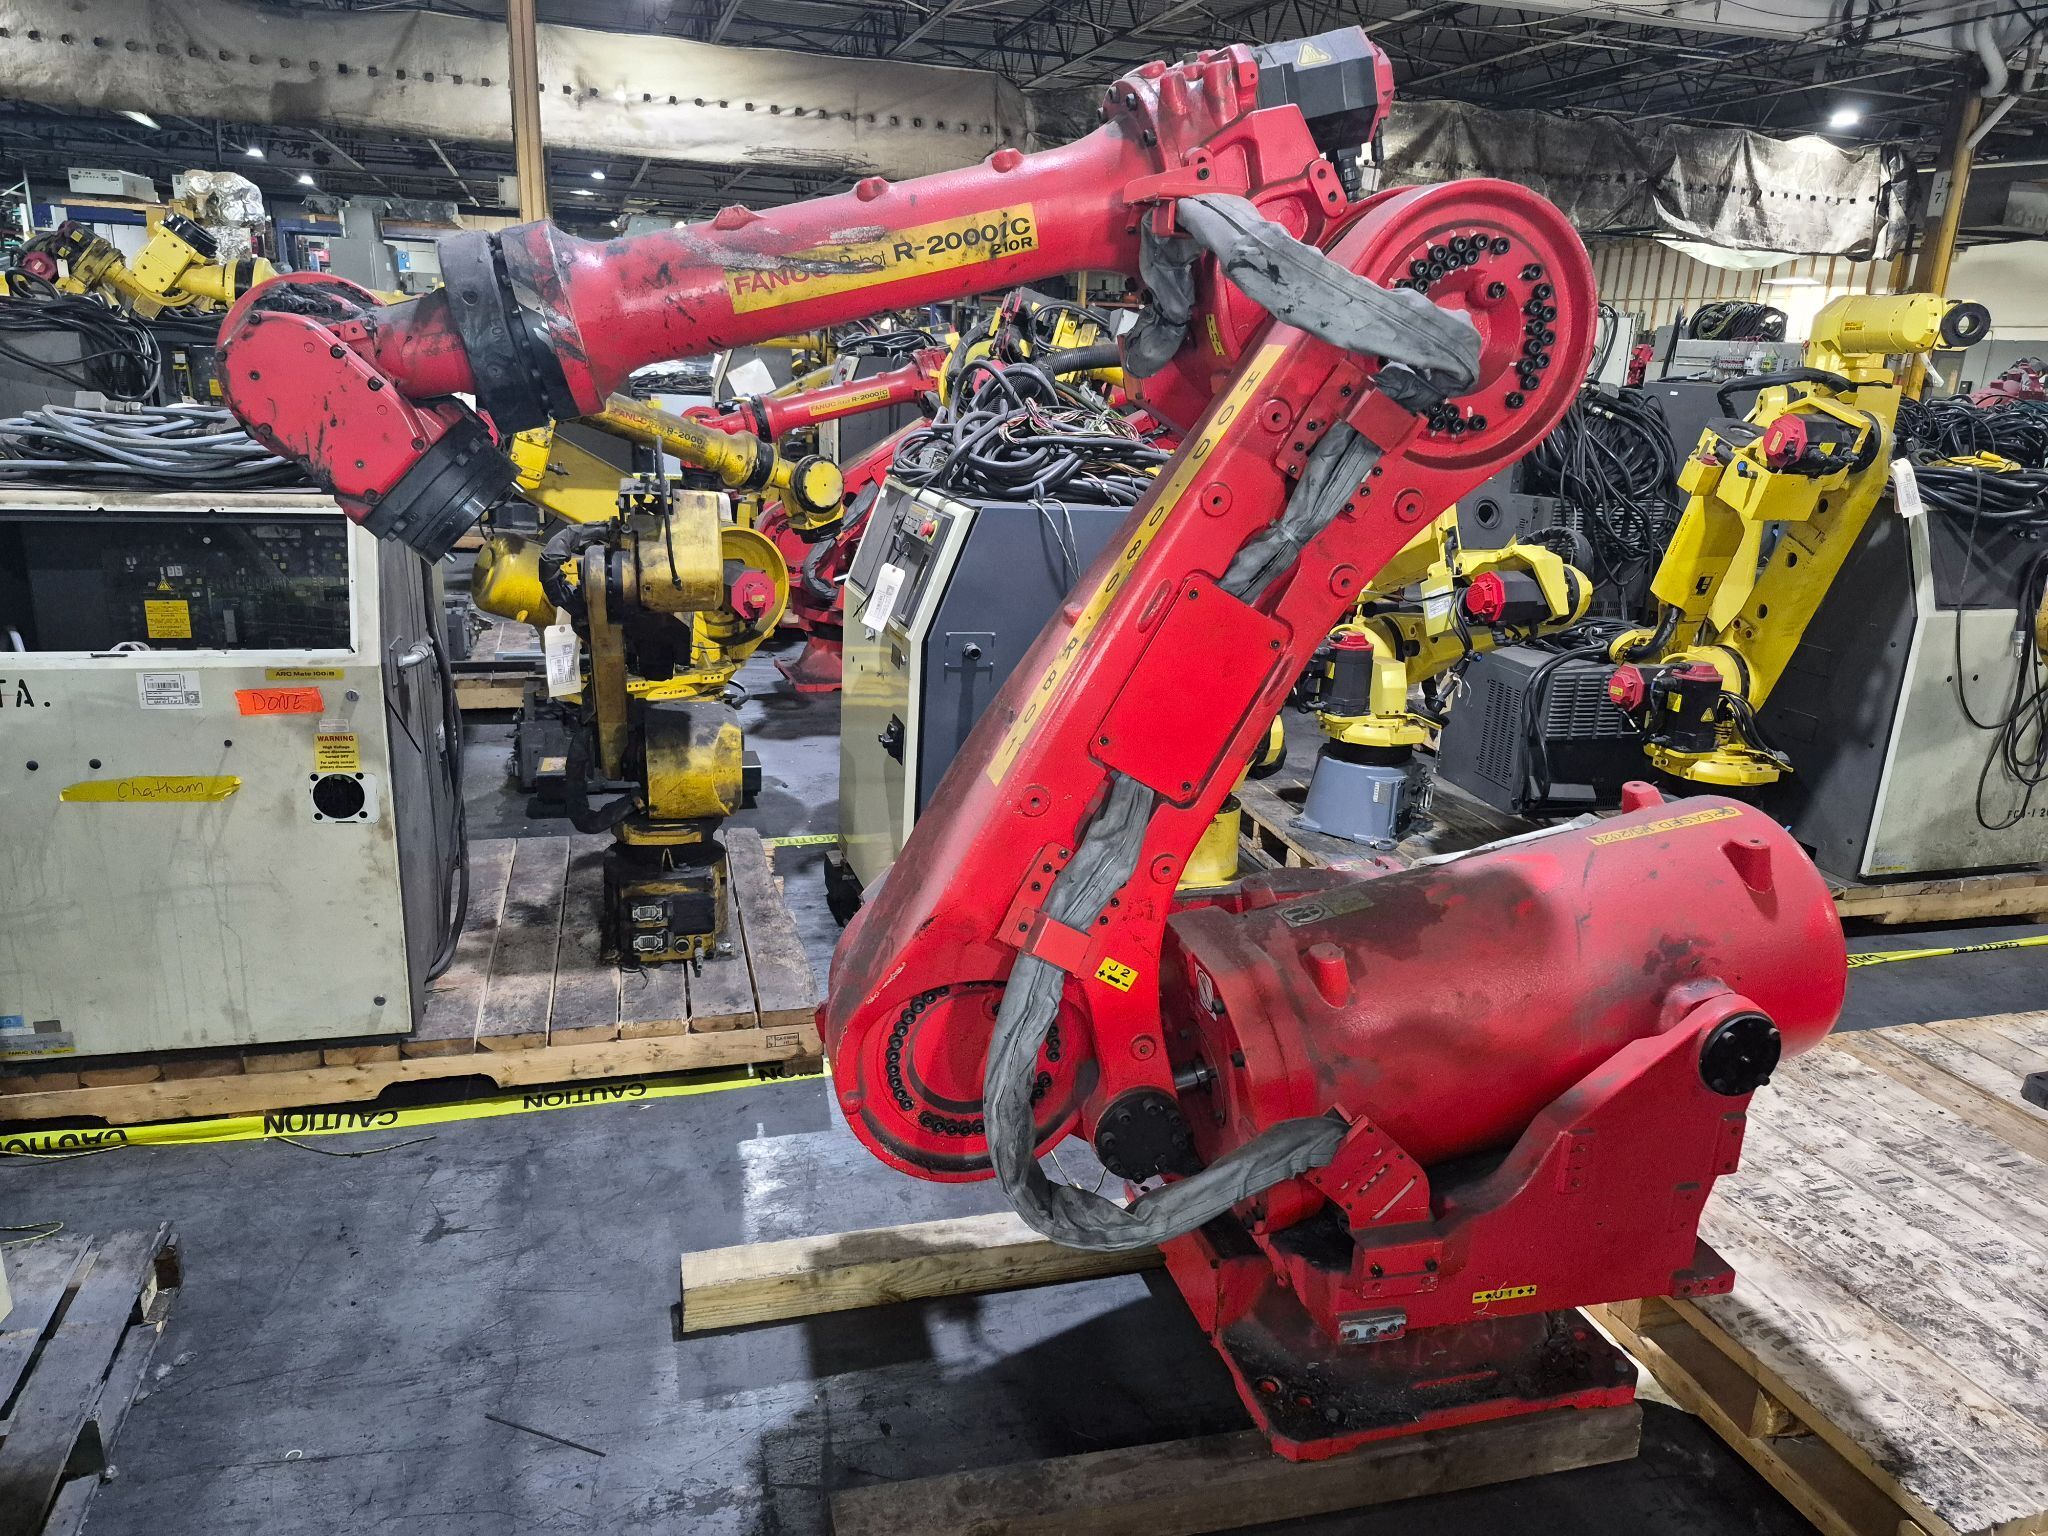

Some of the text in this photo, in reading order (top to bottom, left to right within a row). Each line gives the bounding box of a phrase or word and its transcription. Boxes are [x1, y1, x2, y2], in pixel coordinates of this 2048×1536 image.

[1935, 192, 1942, 204] 7
[894, 212, 1031, 263] R-2000iC
[991, 236, 1034, 256] 210R
[252, 692, 304, 711] DONE
[117, 781, 205, 799] Chatham
[522, 1082, 647, 1110] CAUTION
[263, 1110, 399, 1135] CAUTION
